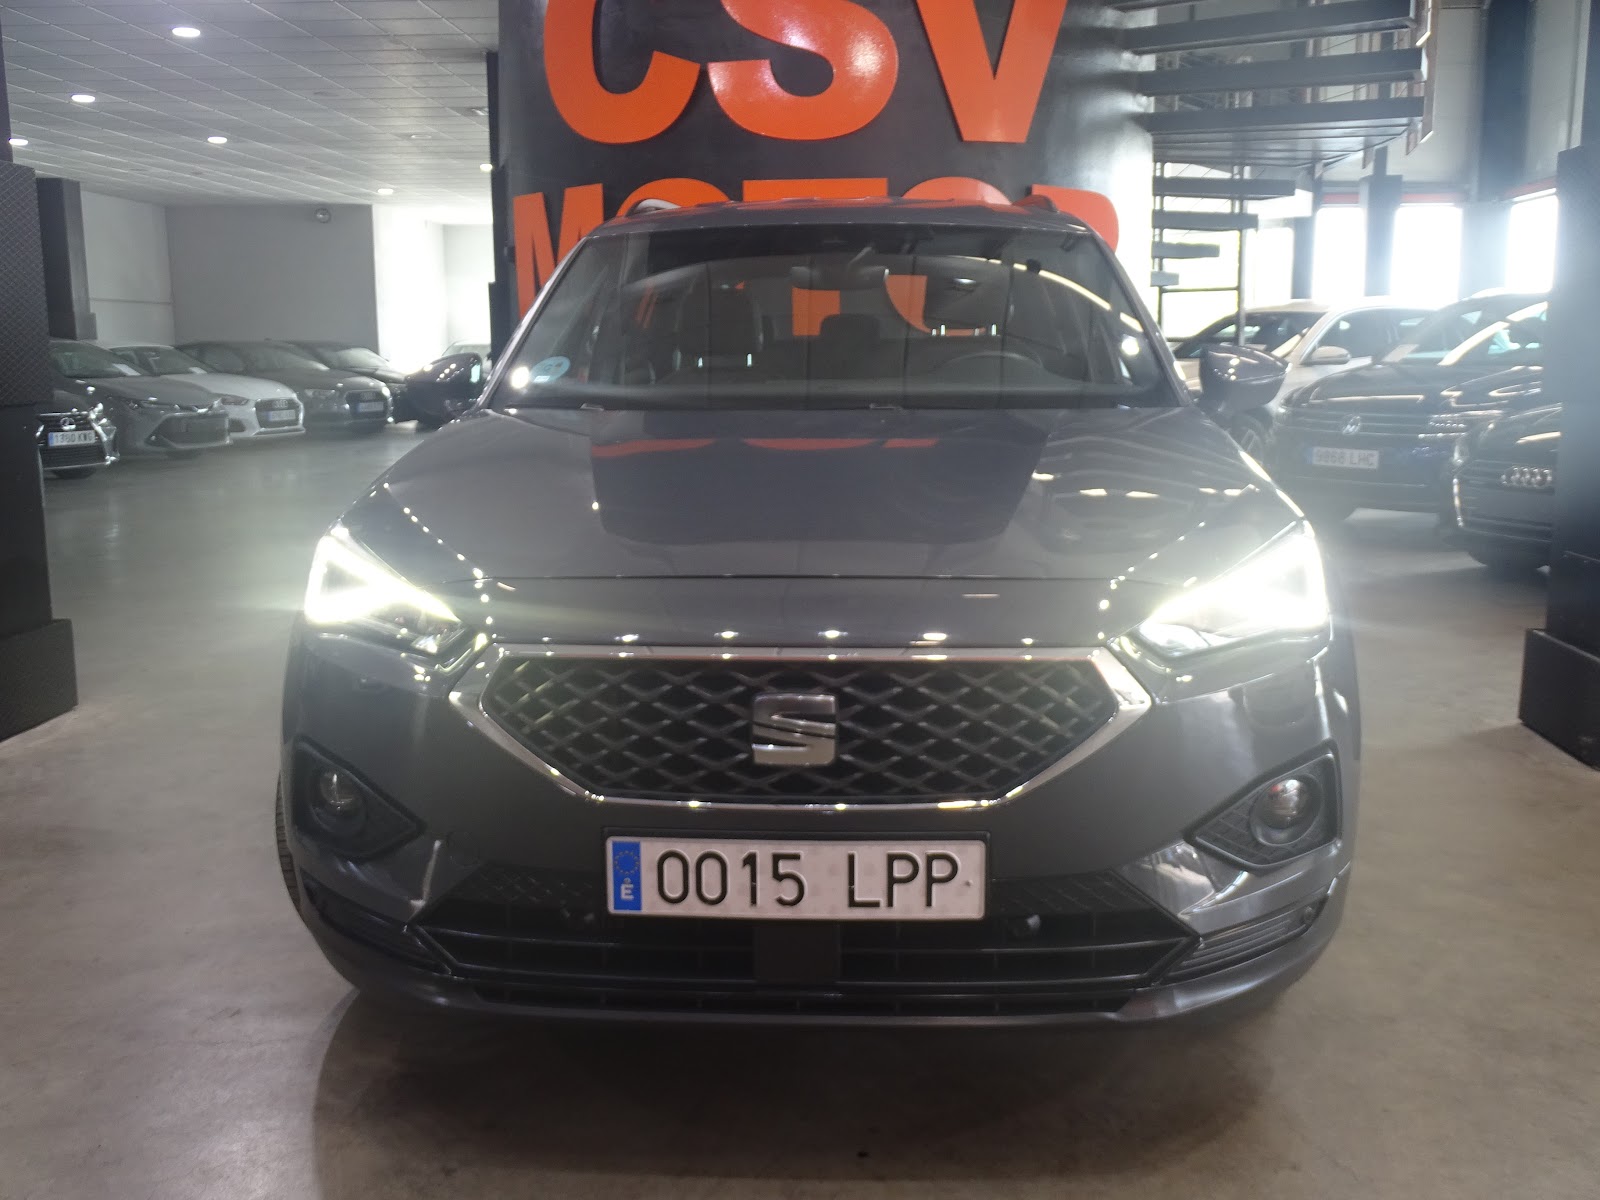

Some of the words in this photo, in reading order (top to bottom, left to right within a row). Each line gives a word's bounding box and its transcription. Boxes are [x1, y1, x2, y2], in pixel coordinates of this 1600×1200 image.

[544, 0, 1068, 144] CSV
[657, 849, 806, 907] 0015
[848, 850, 961, 908] LPP
